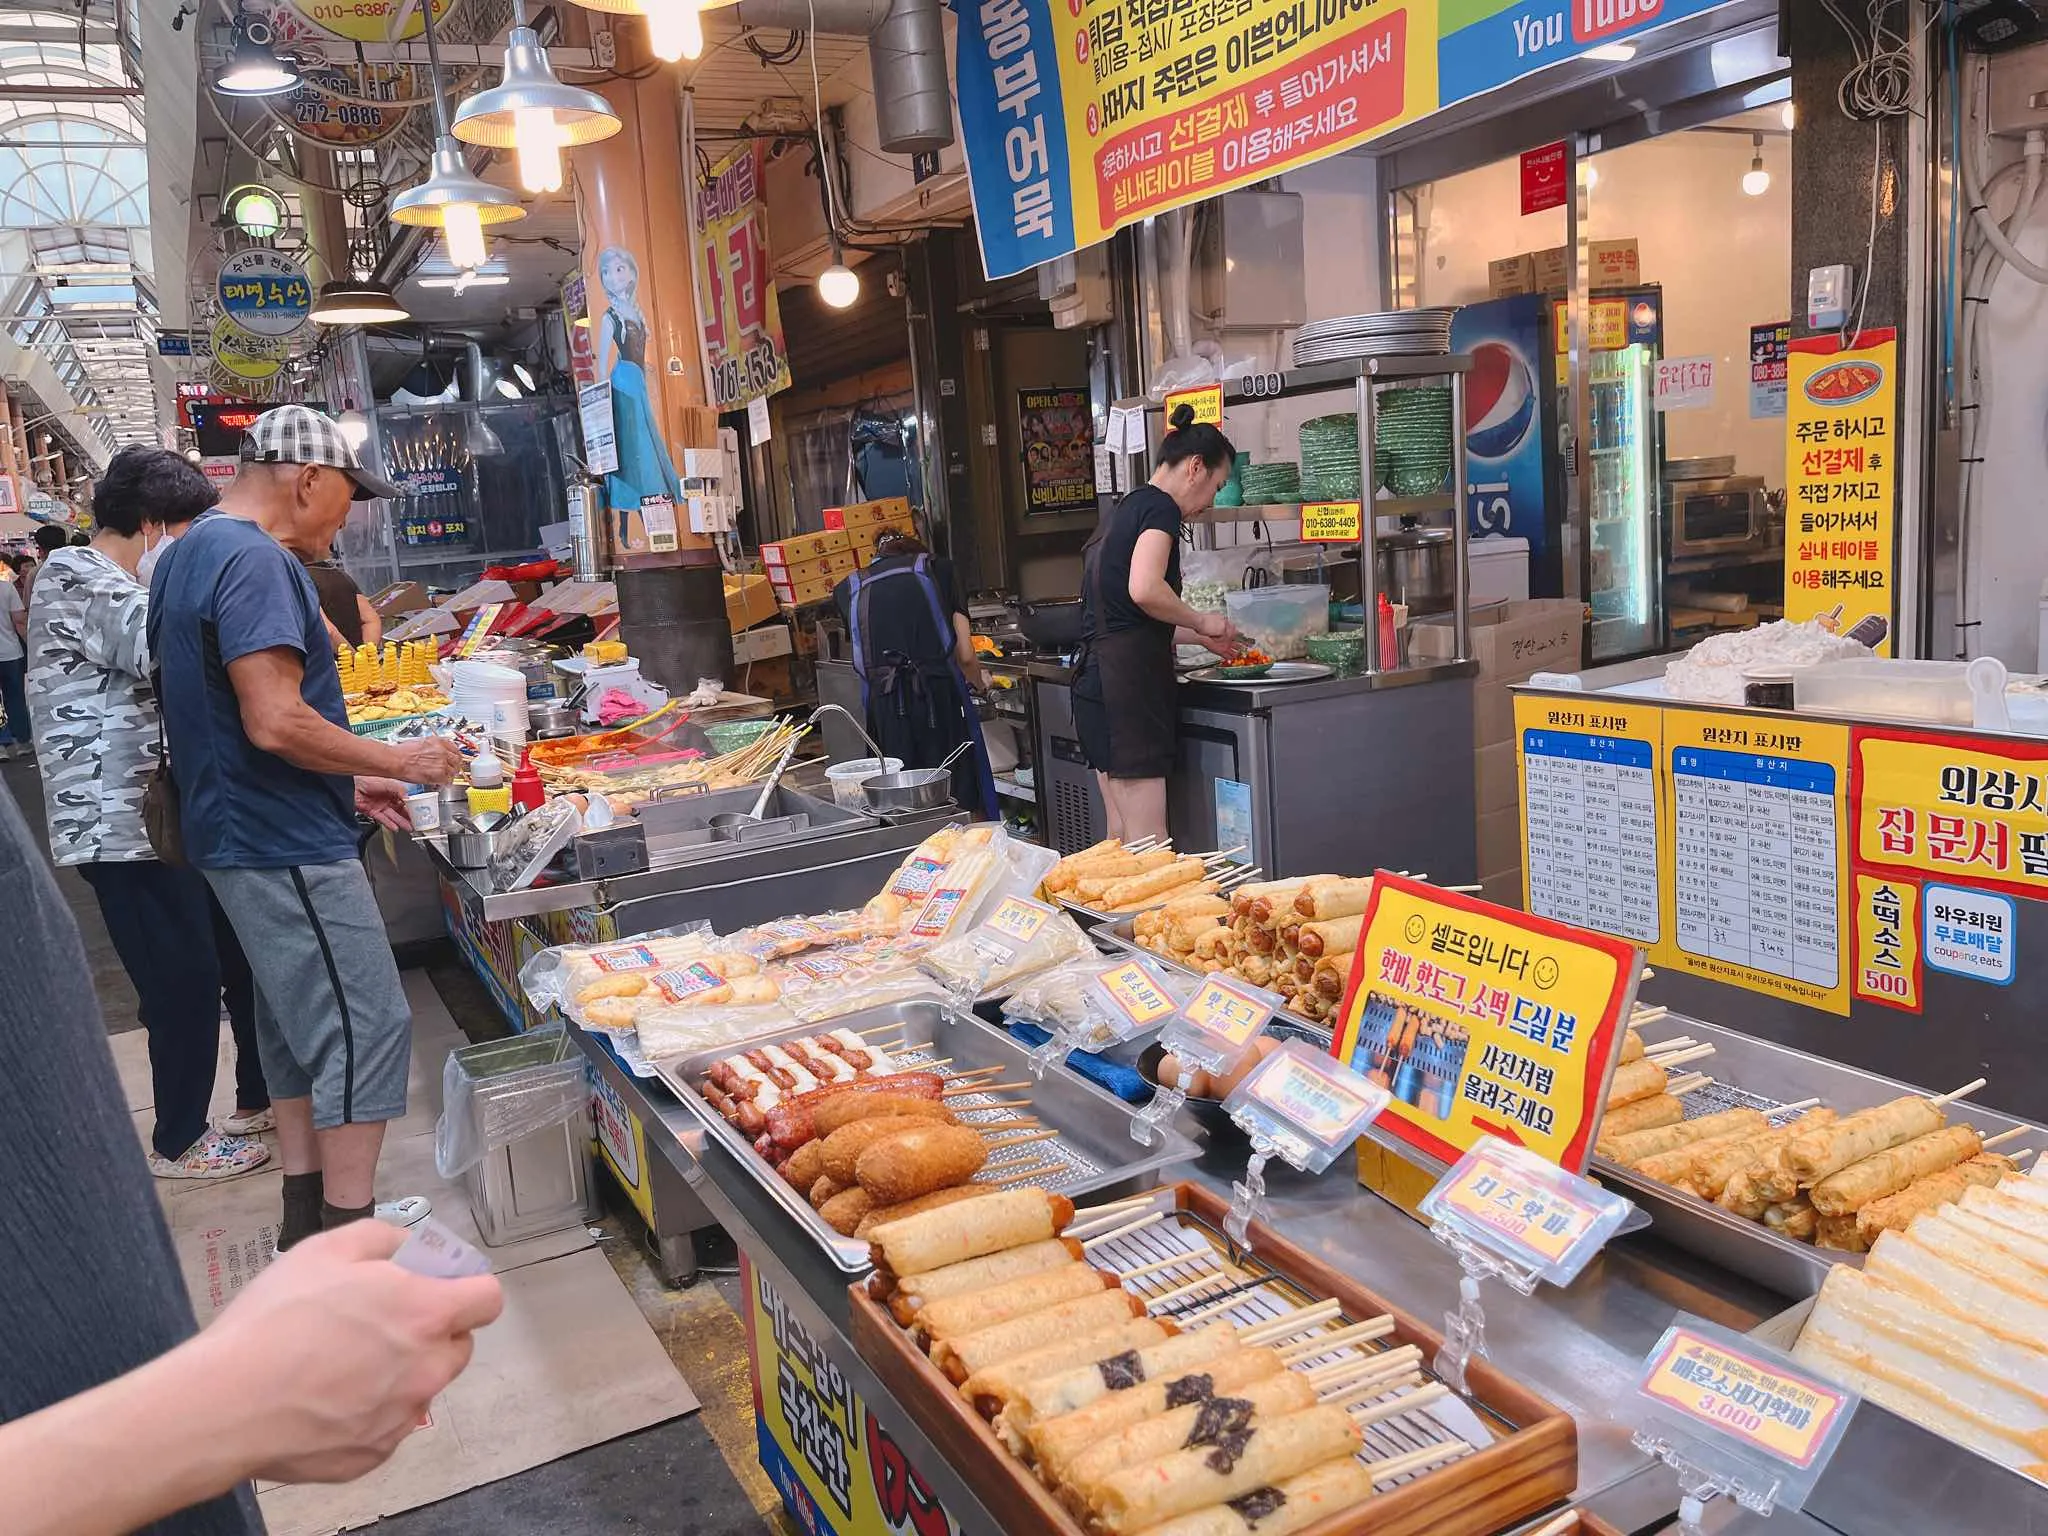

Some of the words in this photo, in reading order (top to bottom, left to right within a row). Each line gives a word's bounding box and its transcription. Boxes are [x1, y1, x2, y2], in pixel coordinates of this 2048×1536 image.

[1512, 12, 1563, 57] You
[1152, 44, 1218, 104] 주문은
[1168, 93, 1249, 154] 선결제
[1255, 91, 1276, 119] 후
[1280, 33, 1393, 108] 들어가셔서
[295, 103, 382, 126] 272-0886
[920, 152, 932, 176] 14
[1112, 146, 1216, 212] 실내테이블
[1222, 96, 1359, 173] 이용해주세요
[223, 281, 308, 308] 태영수산
[1796, 421, 1829, 443] 주문
[1833, 416, 1886, 440] 하시고
[1801, 447, 1864, 476] 선결제
[1868, 452, 1883, 472] 후
[1799, 484, 1829, 504] 직접
[1832, 482, 1881, 502] 가지고
[1305, 516, 1356, 528] 010-6380-4409
[1799, 511, 1878, 533] 들어가셔서
[1798, 541, 1828, 561] 실내
[1832, 540, 1879, 561] 테이블
[1792, 569, 1885, 590] 이용해주세요
[1547, 711, 1585, 728] 원산지
[1589, 714, 1628, 732] 표시판
[1702, 727, 1748, 746] 원산지
[1754, 732, 1802, 752] 표시판
[1766, 775, 1771, 783] 2
[1878, 807, 1915, 856] 집
[1927, 812, 2009, 871] 문서
[1873, 884, 1901, 970] 소떡소스
[1934, 904, 2003, 933] 와우회원
[1430, 922, 1531, 982] 셀프입니다
[1933, 925, 2003, 955] 무료배달
[1934, 945, 1978, 967] coupang
[1979, 956, 2003, 969] eats
[1865, 969, 1908, 998] 500
[1204, 989, 1256, 1027] 핫도그
[1379, 947, 1413, 995] 핫바,
[1414, 960, 1468, 1018] 핫도그,
[1468, 983, 1512, 1028] 소떡
[1508, 996, 1552, 1043] 드실
[1551, 1010, 1578, 1055] 분
[1478, 1042, 1555, 1098] 사진처럼
[1463, 1073, 1556, 1137] 올려주세요
